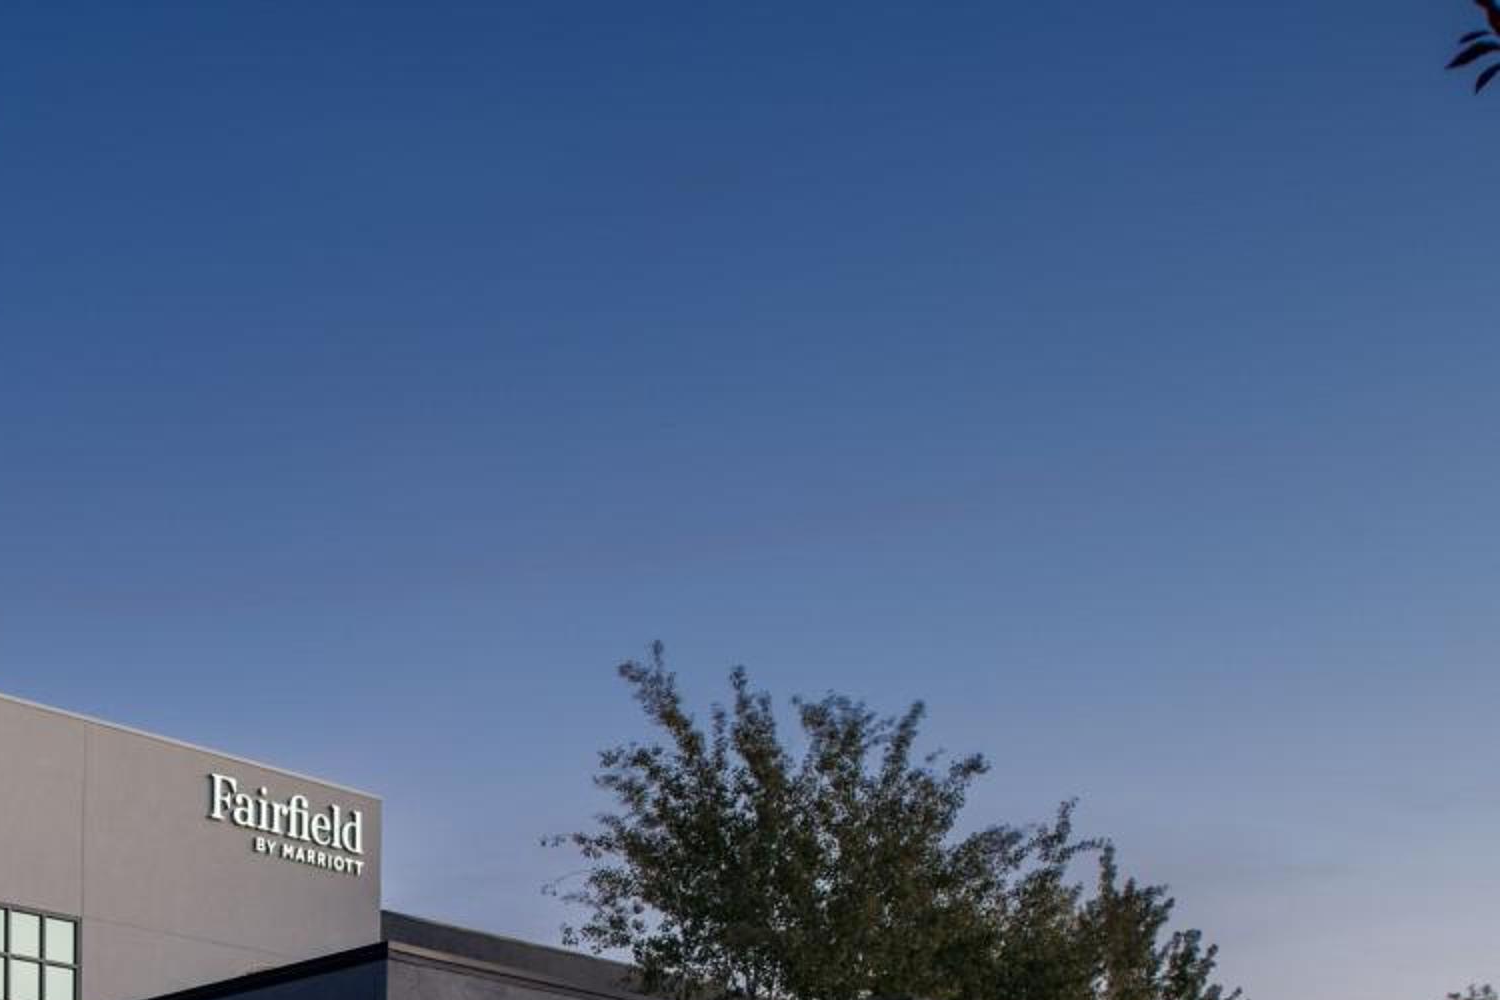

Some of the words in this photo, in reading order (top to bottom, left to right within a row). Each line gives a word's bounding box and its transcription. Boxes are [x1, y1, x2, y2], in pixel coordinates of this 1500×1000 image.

[210, 773, 364, 854] Fairfield
[256, 837, 276, 854] BY
[282, 843, 365, 876] MARRIOTT
